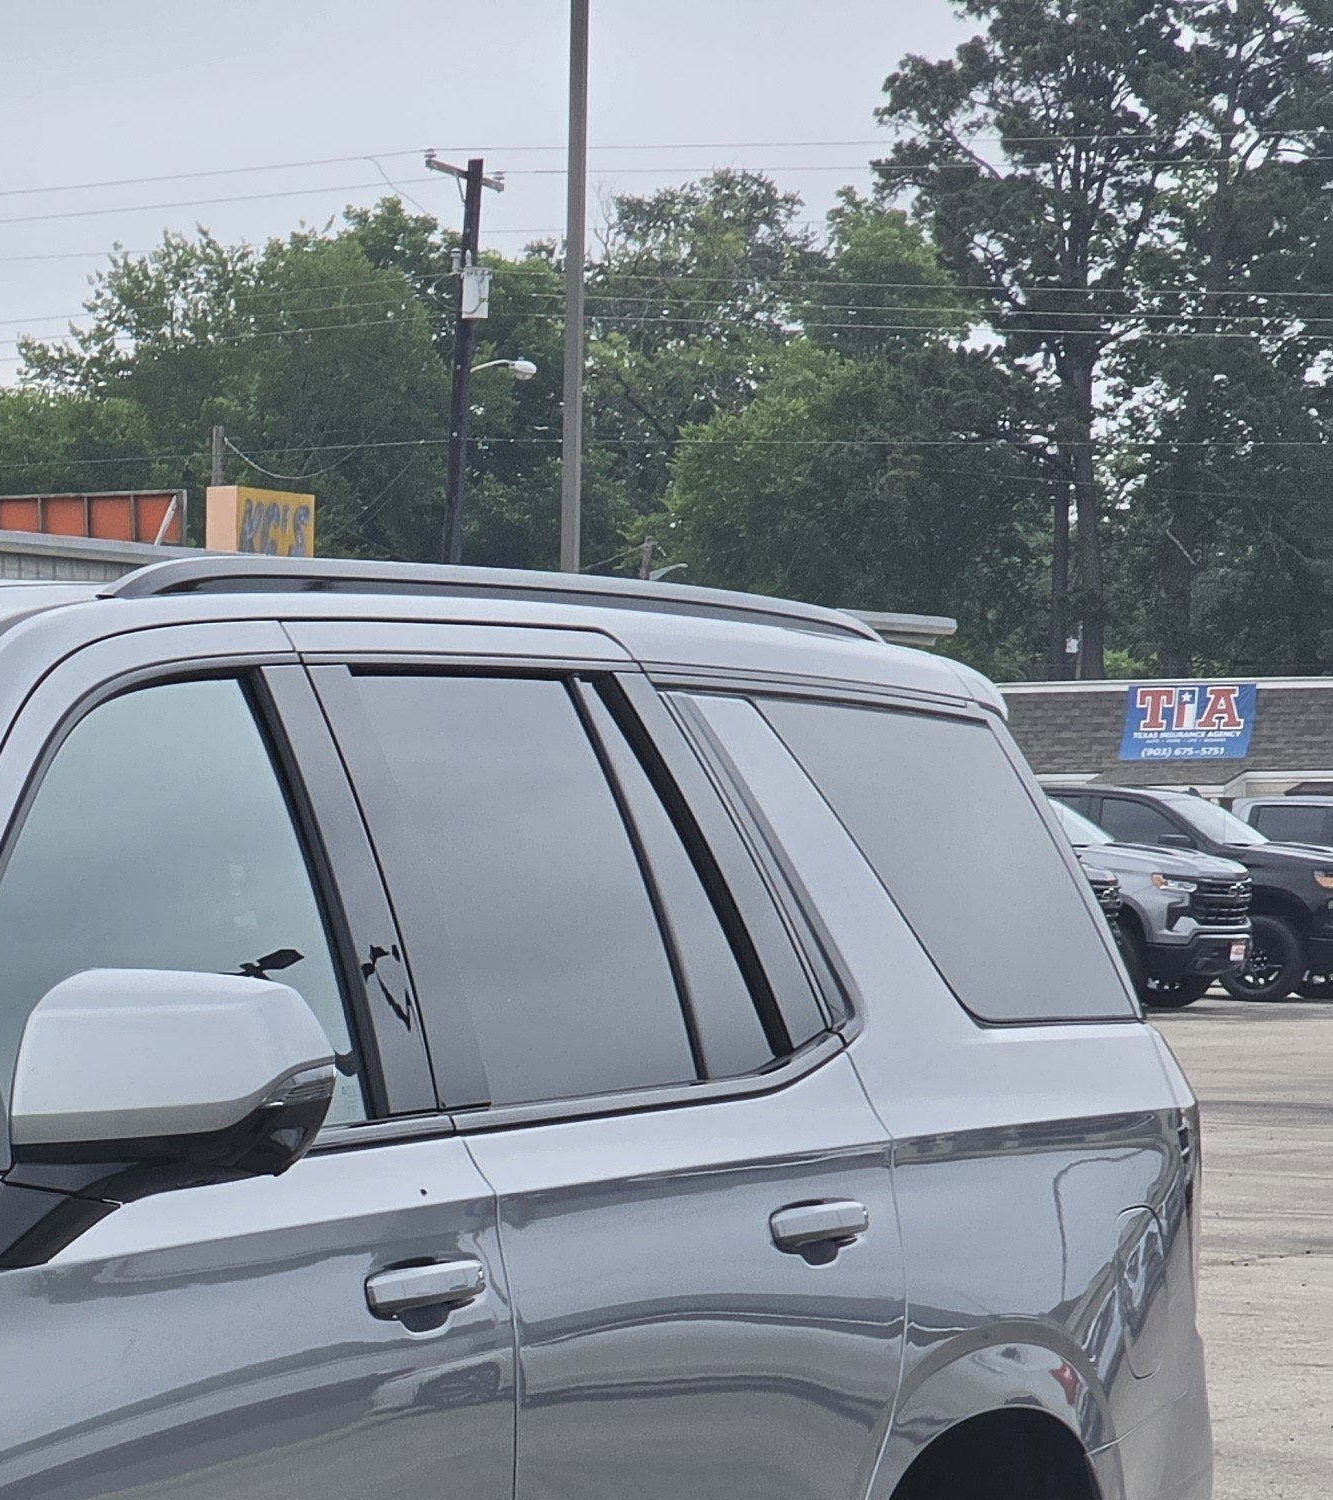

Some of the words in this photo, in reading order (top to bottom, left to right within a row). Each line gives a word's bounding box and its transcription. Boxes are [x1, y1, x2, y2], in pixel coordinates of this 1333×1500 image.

[1133, 731, 1158, 739] TEXAS
[1207, 730, 1241, 738] AGENCY
[1141, 747, 1171, 758] (903)
